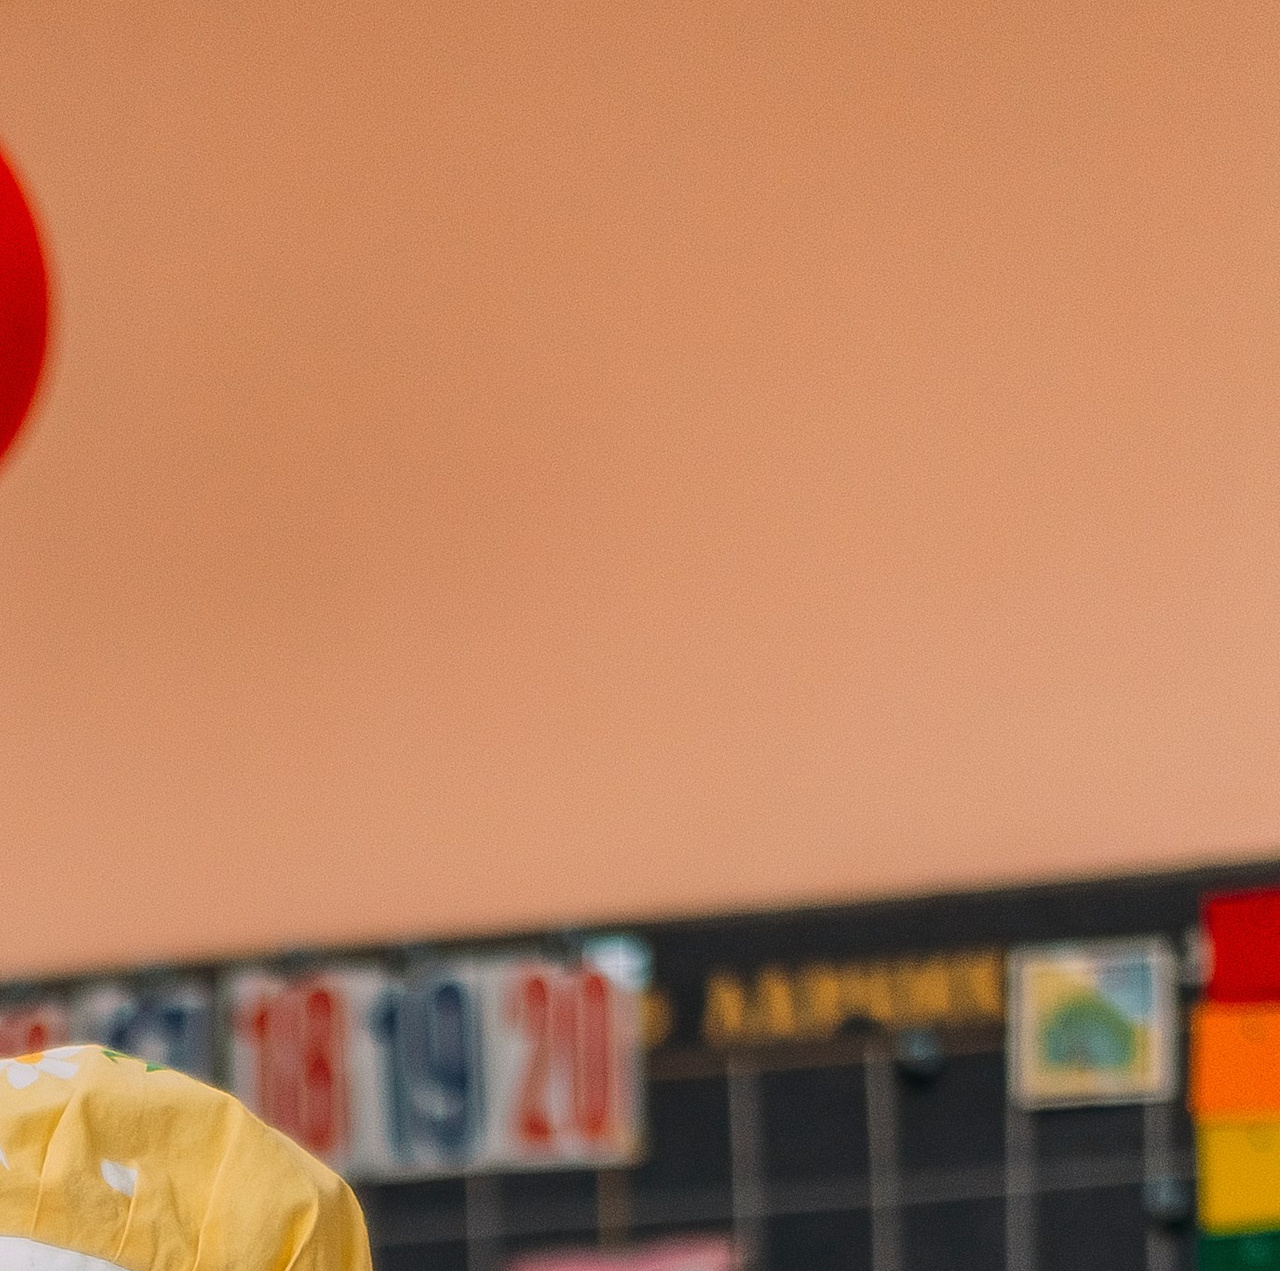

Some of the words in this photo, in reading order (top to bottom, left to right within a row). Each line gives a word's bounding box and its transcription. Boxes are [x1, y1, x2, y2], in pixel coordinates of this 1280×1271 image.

[234, 986, 350, 1158] 18
[368, 978, 487, 1166] 19
[505, 965, 618, 1155] 20
